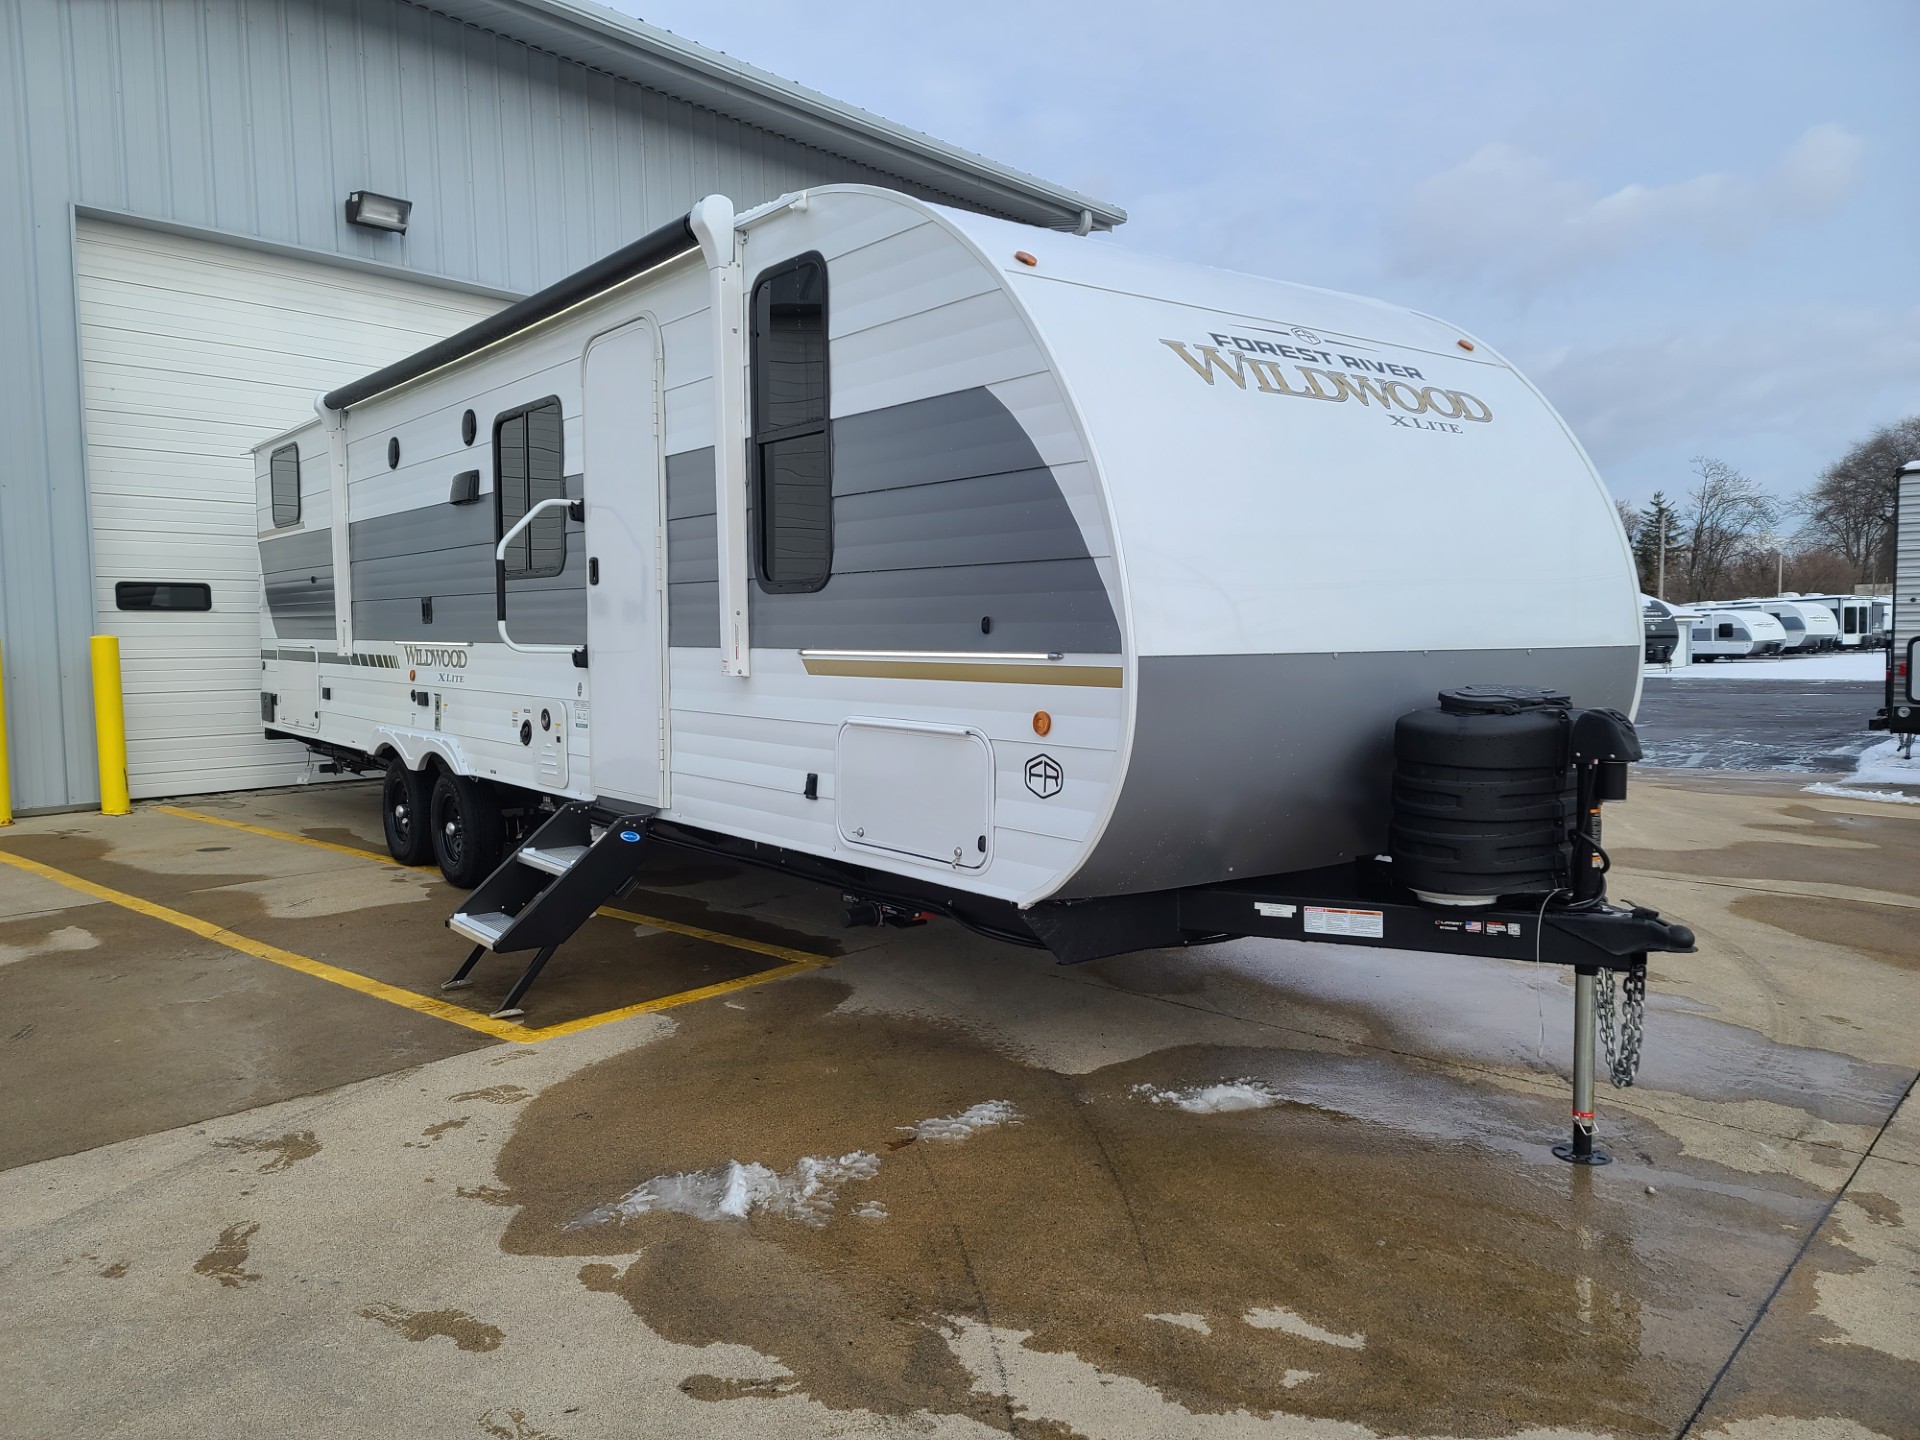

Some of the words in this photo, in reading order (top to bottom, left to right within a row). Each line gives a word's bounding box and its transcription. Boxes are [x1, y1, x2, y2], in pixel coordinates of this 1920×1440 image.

[1158, 338, 1494, 423] WILDWOOD
[1207, 332, 1332, 365] FOREST
[1336, 354, 1427, 381] RIVER
[403, 645, 468, 669] WILDWOOD
